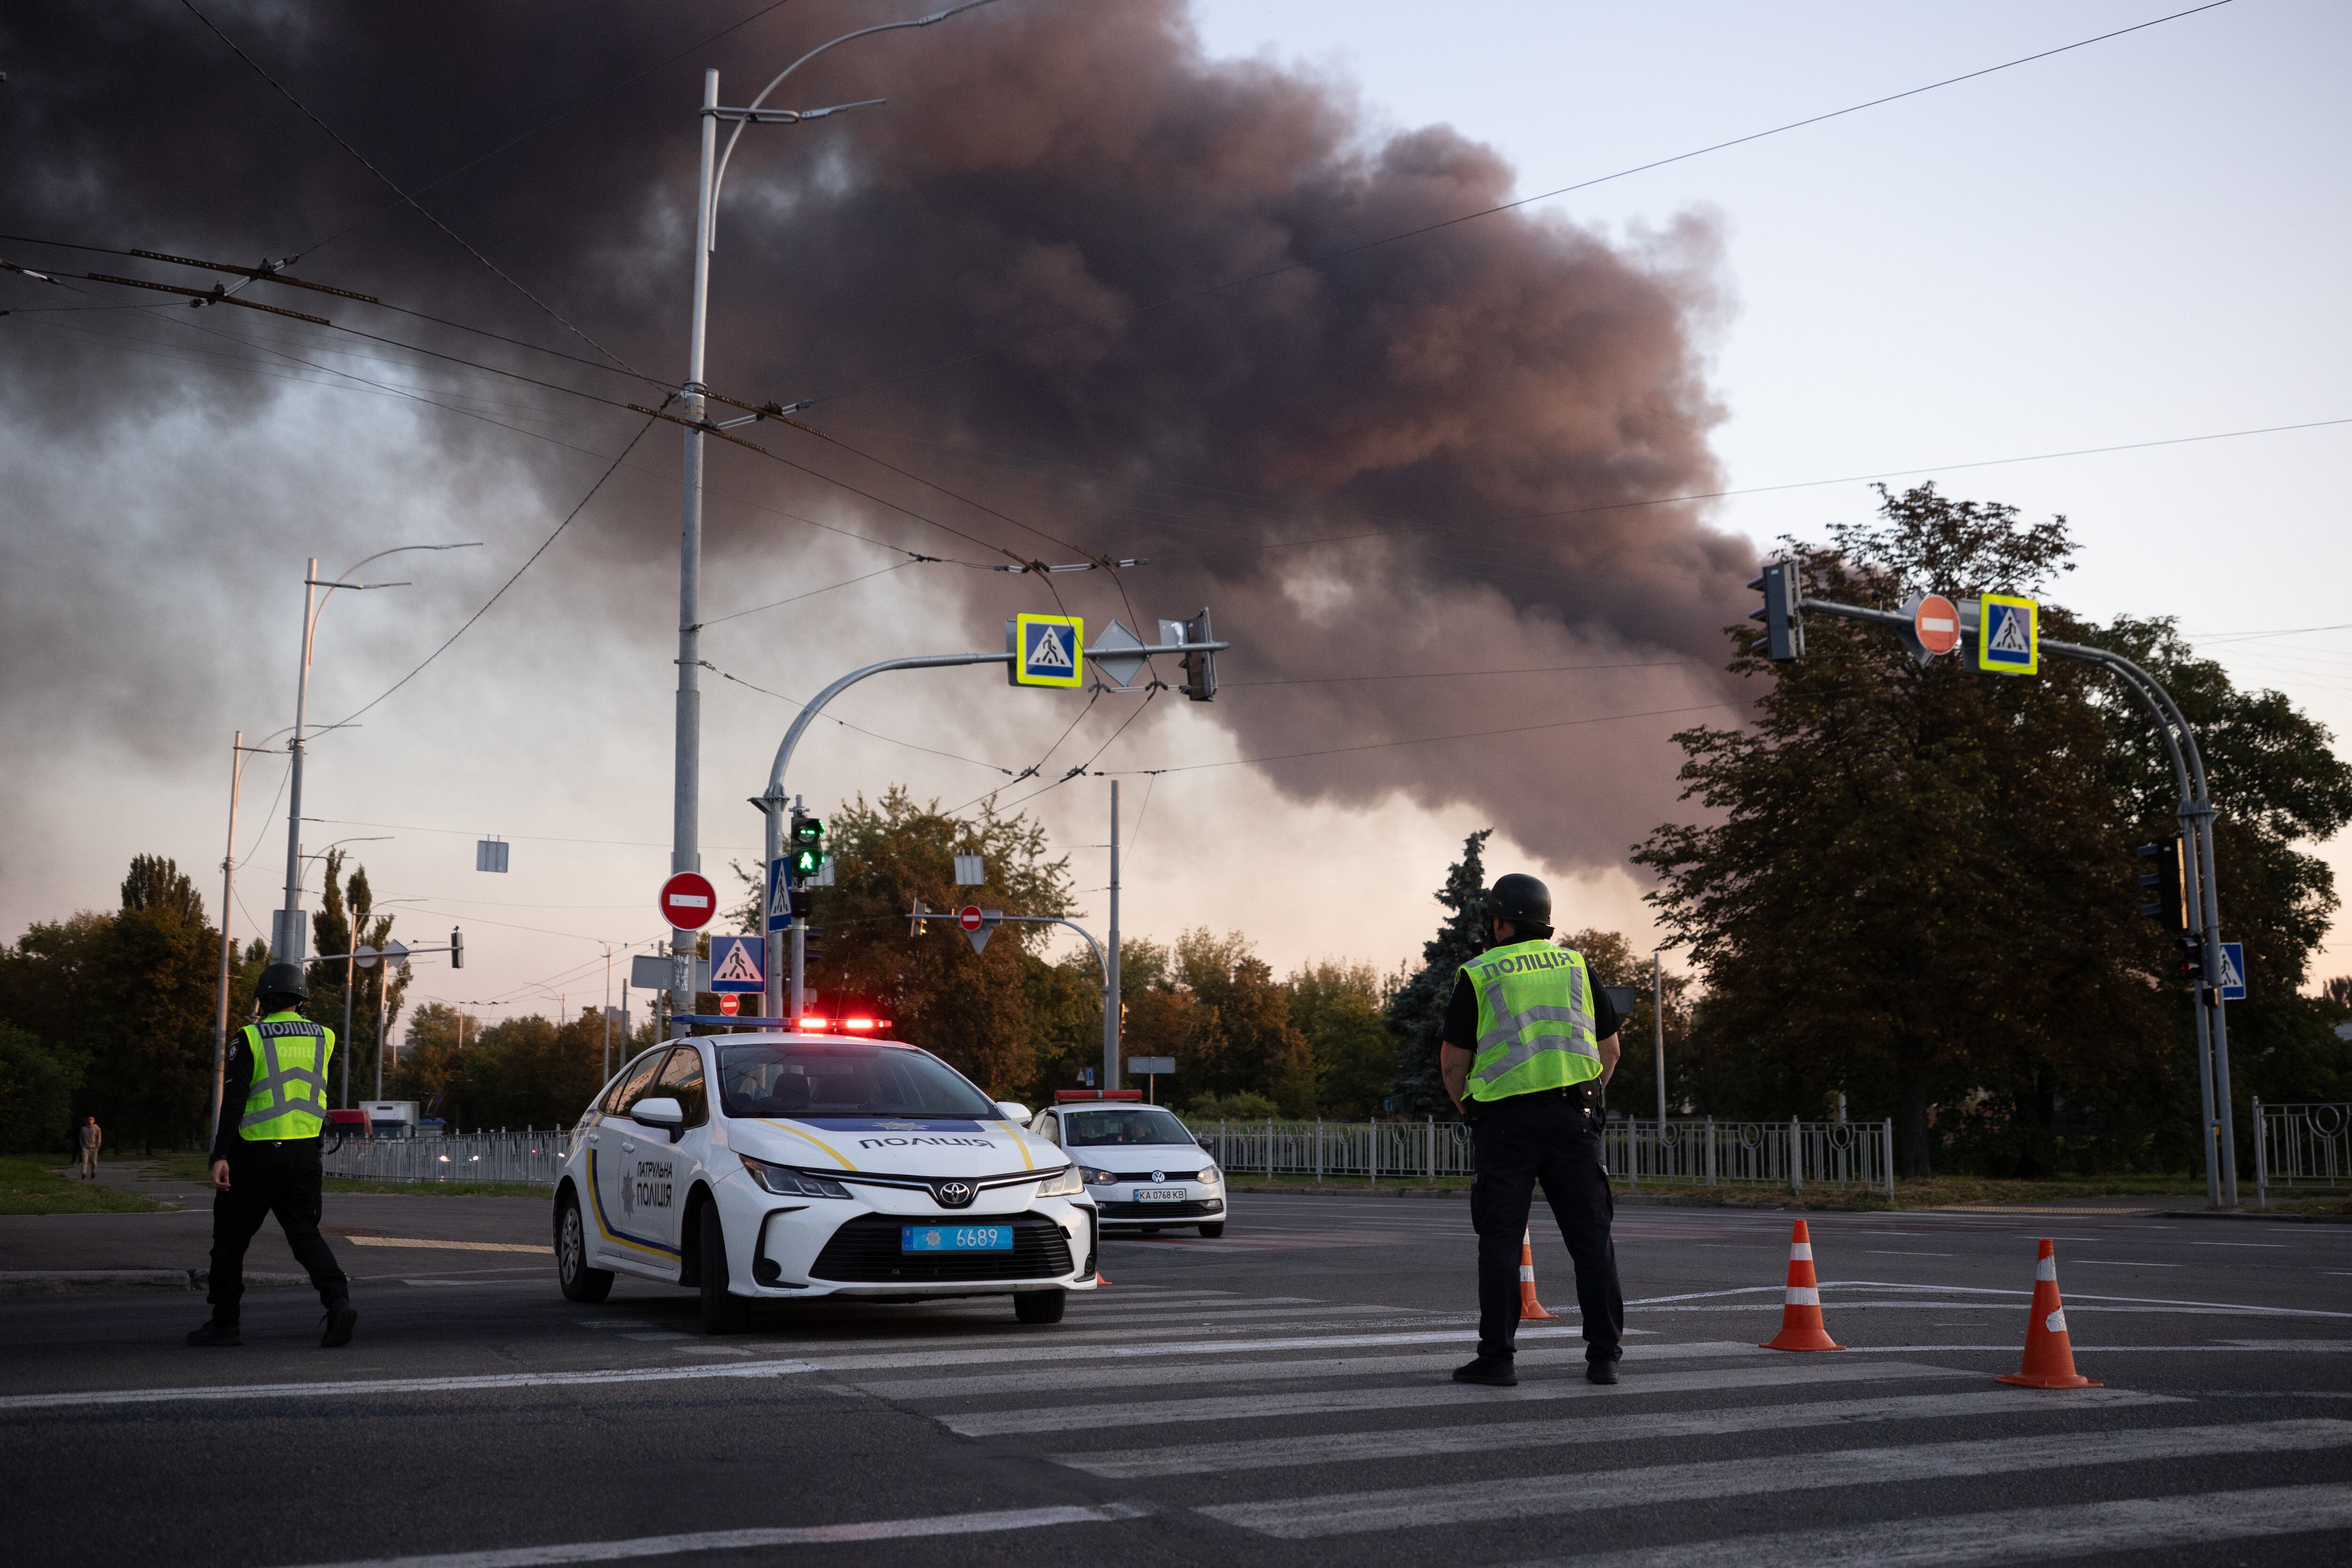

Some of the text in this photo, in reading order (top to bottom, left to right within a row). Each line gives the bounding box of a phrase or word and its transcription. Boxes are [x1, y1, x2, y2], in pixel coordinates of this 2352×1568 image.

[1482, 952, 1574, 980] ПОЛІЦІЯ
[260, 1022, 324, 1036] ПОЛІЦІЯ
[859, 1138, 996, 1149] ПОЛІЦІЯ
[637, 1162, 672, 1178] ПАТРУЛЬНА
[637, 1183, 672, 1207] ПОЛІЦІЯ
[956, 1228, 998, 1247] 6689
